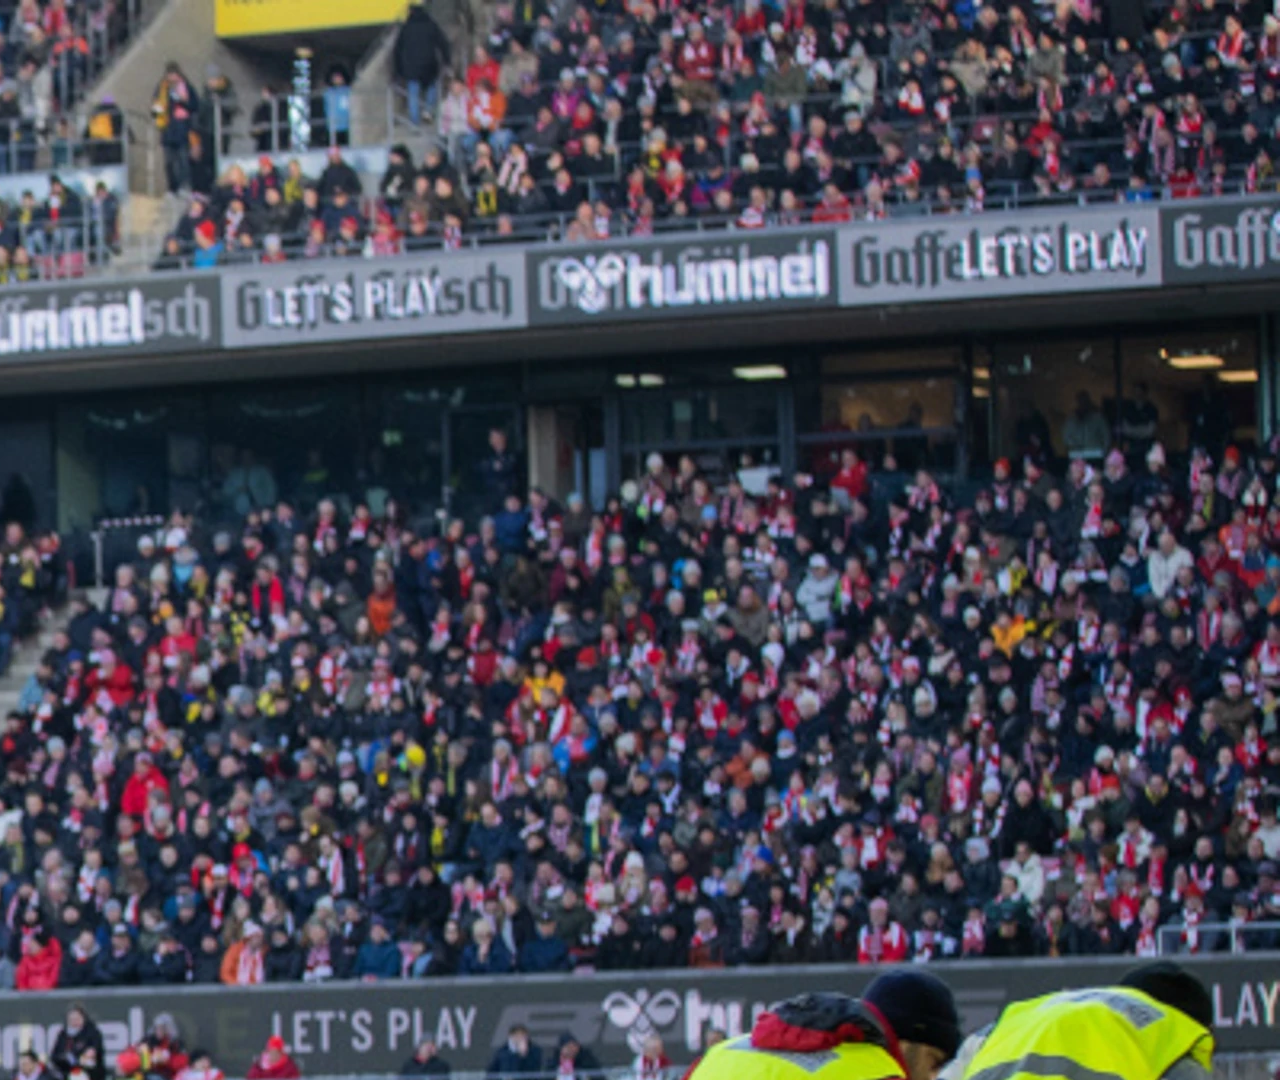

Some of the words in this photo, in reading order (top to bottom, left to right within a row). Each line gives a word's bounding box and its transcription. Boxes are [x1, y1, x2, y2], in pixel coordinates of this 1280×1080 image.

[627, 239, 830, 308] hummel
[960, 231, 1053, 279] LET'S
[1064, 225, 1148, 271] PLAY
[265, 281, 353, 326] LET'S
[364, 274, 442, 319] PLAY
